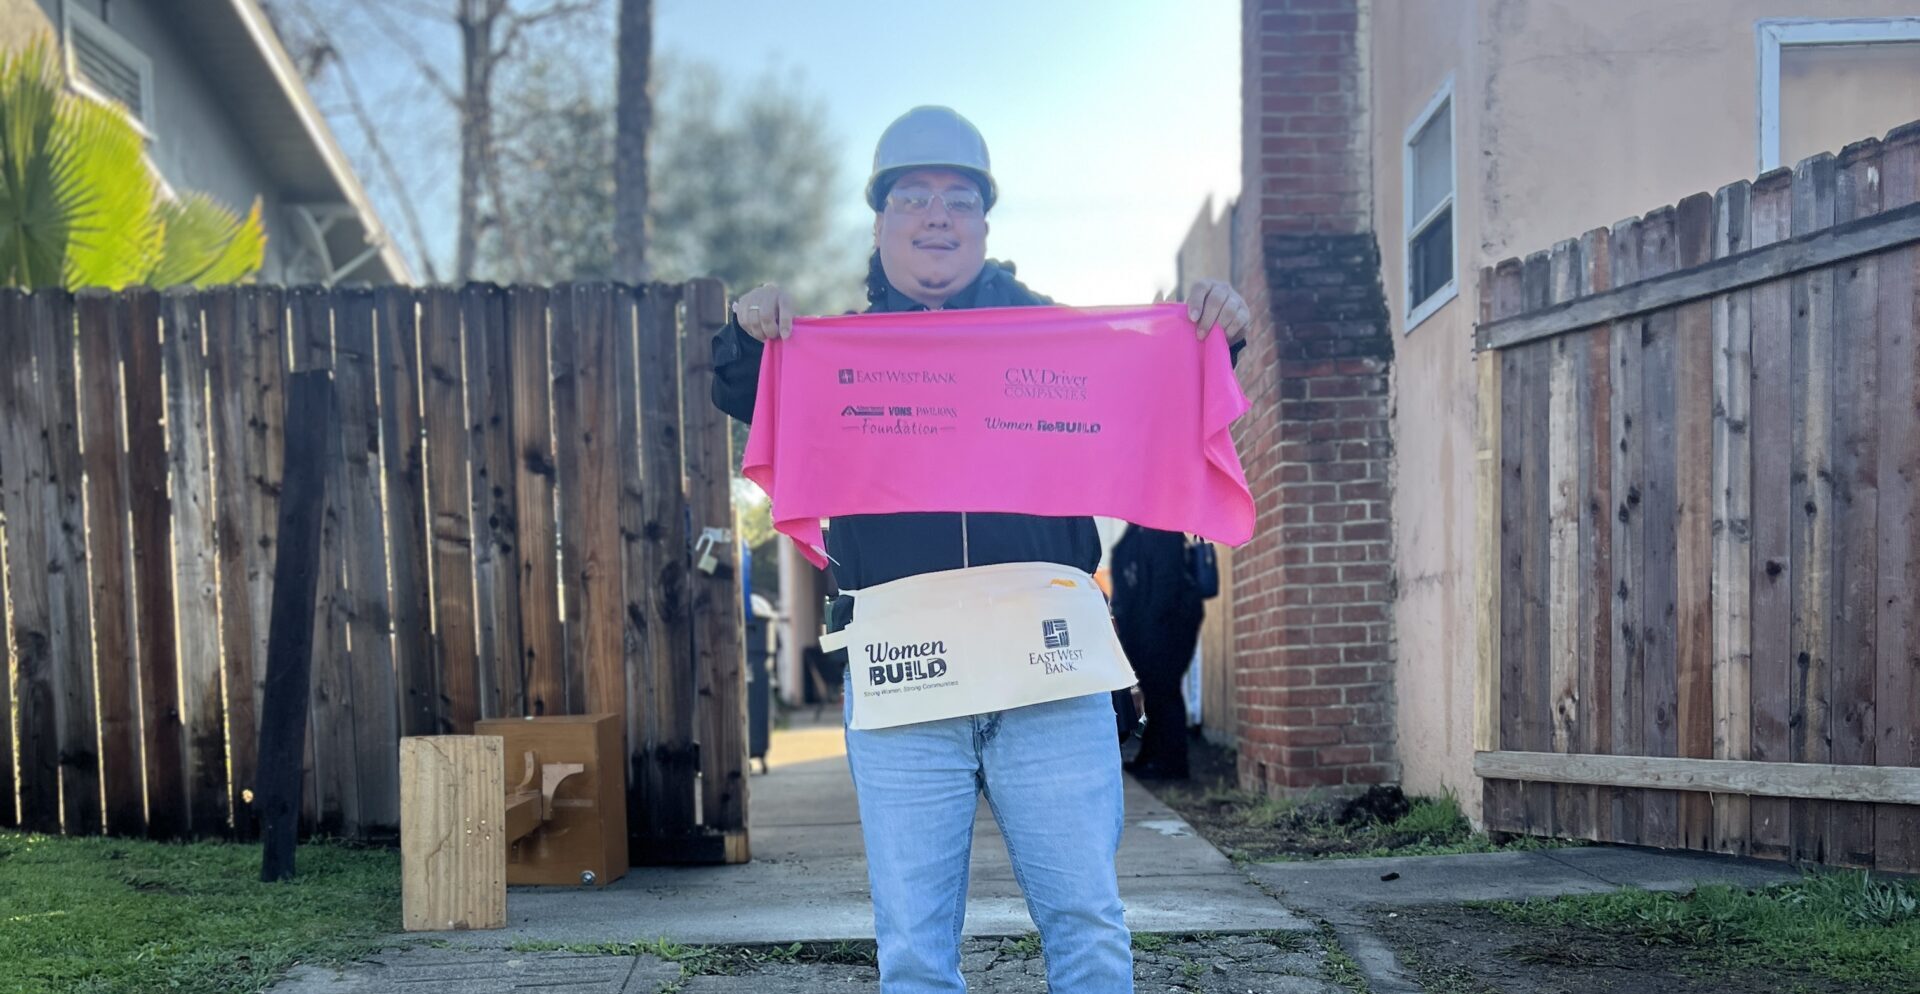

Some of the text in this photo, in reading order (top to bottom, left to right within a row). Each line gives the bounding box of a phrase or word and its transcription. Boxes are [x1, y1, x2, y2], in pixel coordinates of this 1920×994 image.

[857, 370, 957, 384] EAST WEST BANK
[1041, 369, 1088, 387] Driver
[889, 406, 912, 416] VONS
[862, 418, 938, 434] Foundation
[985, 417, 1101, 433] Women ReBUILD
[865, 640, 947, 663] Women
[1029, 648, 1083, 664] EAST WEST
[869, 657, 947, 686] BUILD
[1045, 661, 1079, 675] BANK
[903, 683, 921, 692] Strong
